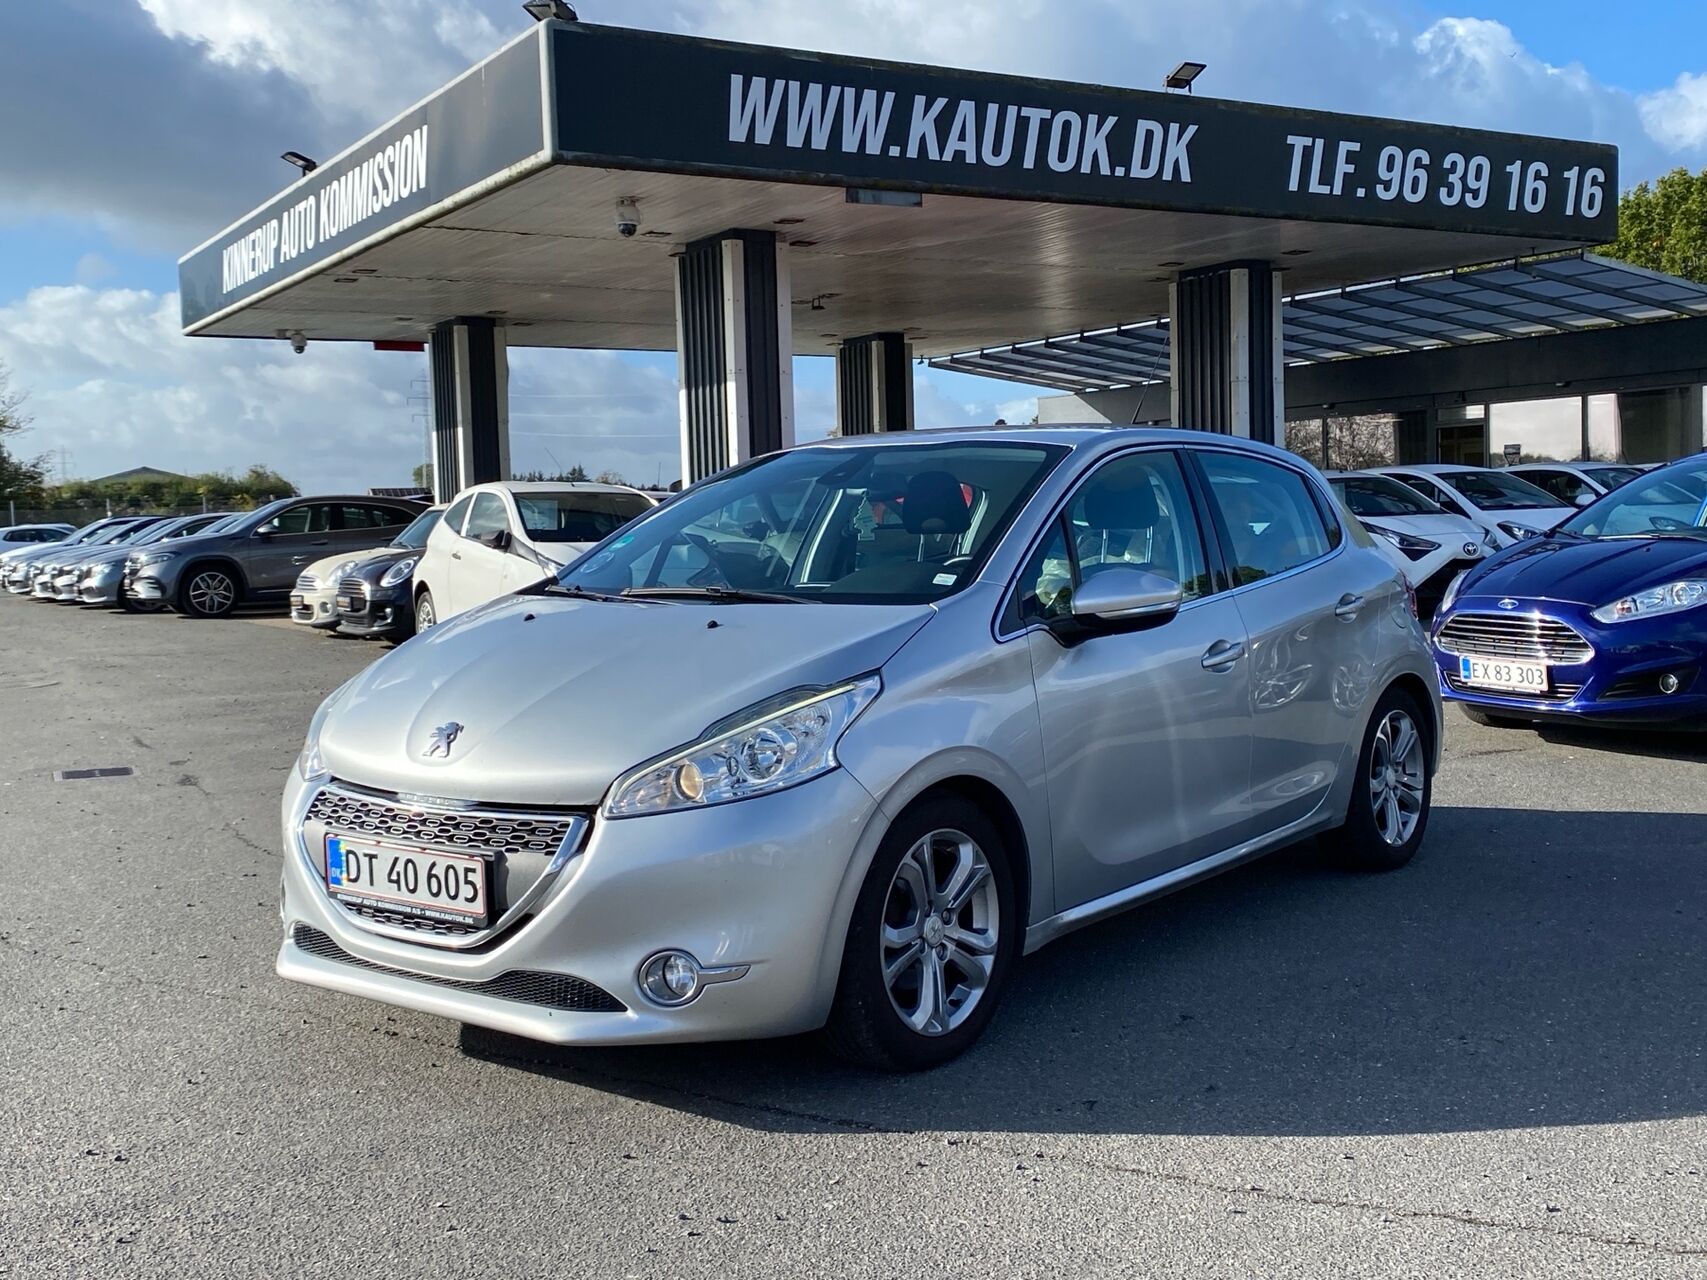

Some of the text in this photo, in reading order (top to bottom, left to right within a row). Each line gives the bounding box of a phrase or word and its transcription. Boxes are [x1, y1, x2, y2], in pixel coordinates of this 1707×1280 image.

[728, 74, 1199, 183] WWW.KAUTOK.DK
[222, 125, 428, 294] KINNERUP AUTO KOMMISSION
[1286, 135, 1605, 218] TLF. 96 39 16 16
[1472, 663, 1544, 685] EX 83 303
[345, 849, 478, 903] DT 40 605
